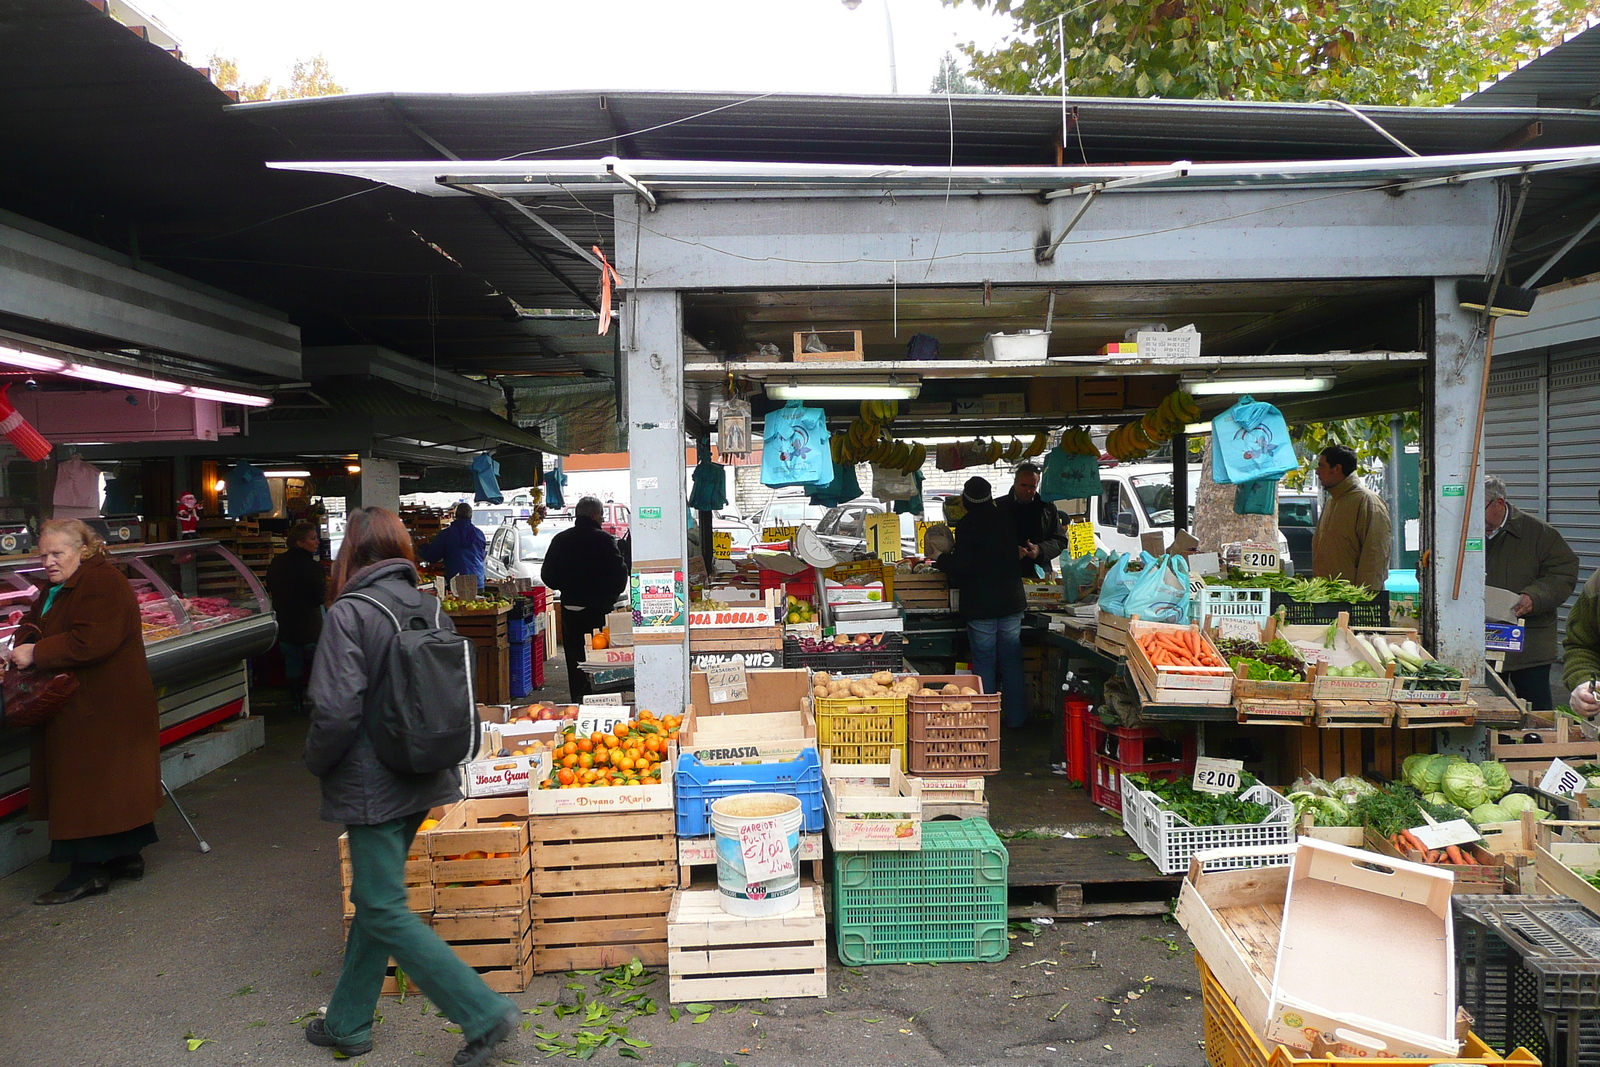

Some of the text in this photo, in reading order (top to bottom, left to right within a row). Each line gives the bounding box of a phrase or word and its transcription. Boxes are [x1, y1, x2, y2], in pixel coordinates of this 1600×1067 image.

[715, 613, 754, 624] ROSSA
[694, 746, 760, 761] COFERASTA
[576, 794, 652, 806] Divano Mario
